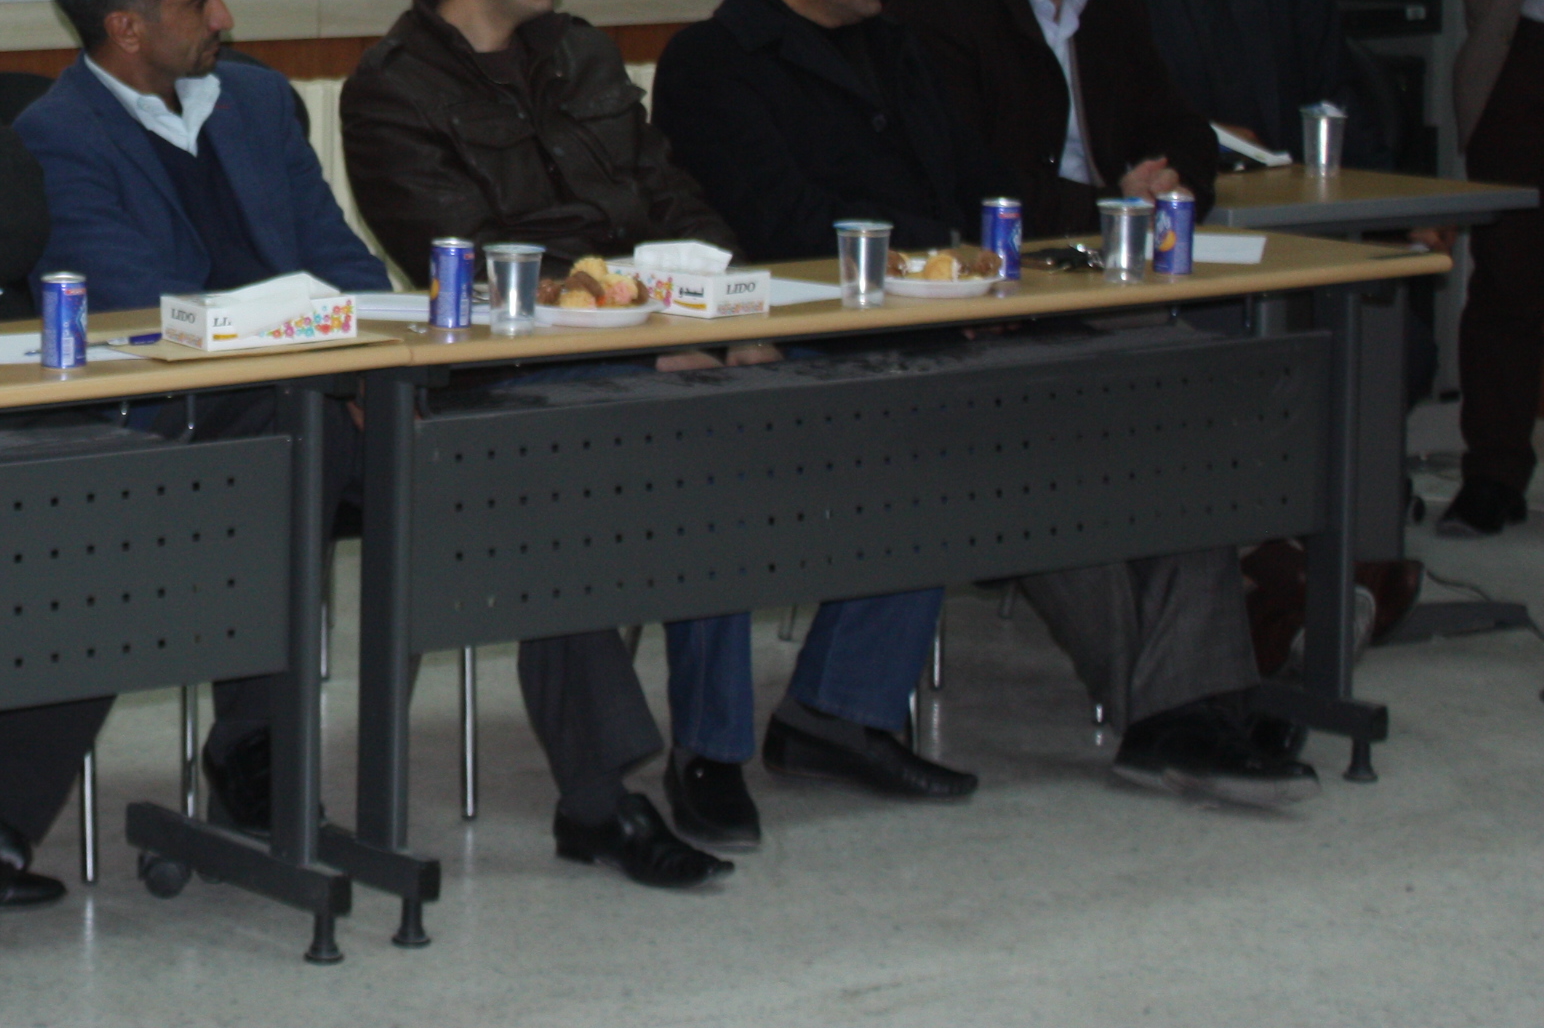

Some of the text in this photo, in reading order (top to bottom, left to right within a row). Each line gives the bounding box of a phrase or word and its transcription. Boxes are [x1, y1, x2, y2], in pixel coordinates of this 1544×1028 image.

[678, 286, 705, 300] ليدو
[726, 282, 756, 295] LIDO
[171, 308, 196, 324] LIDO
[213, 317, 232, 327] LI
